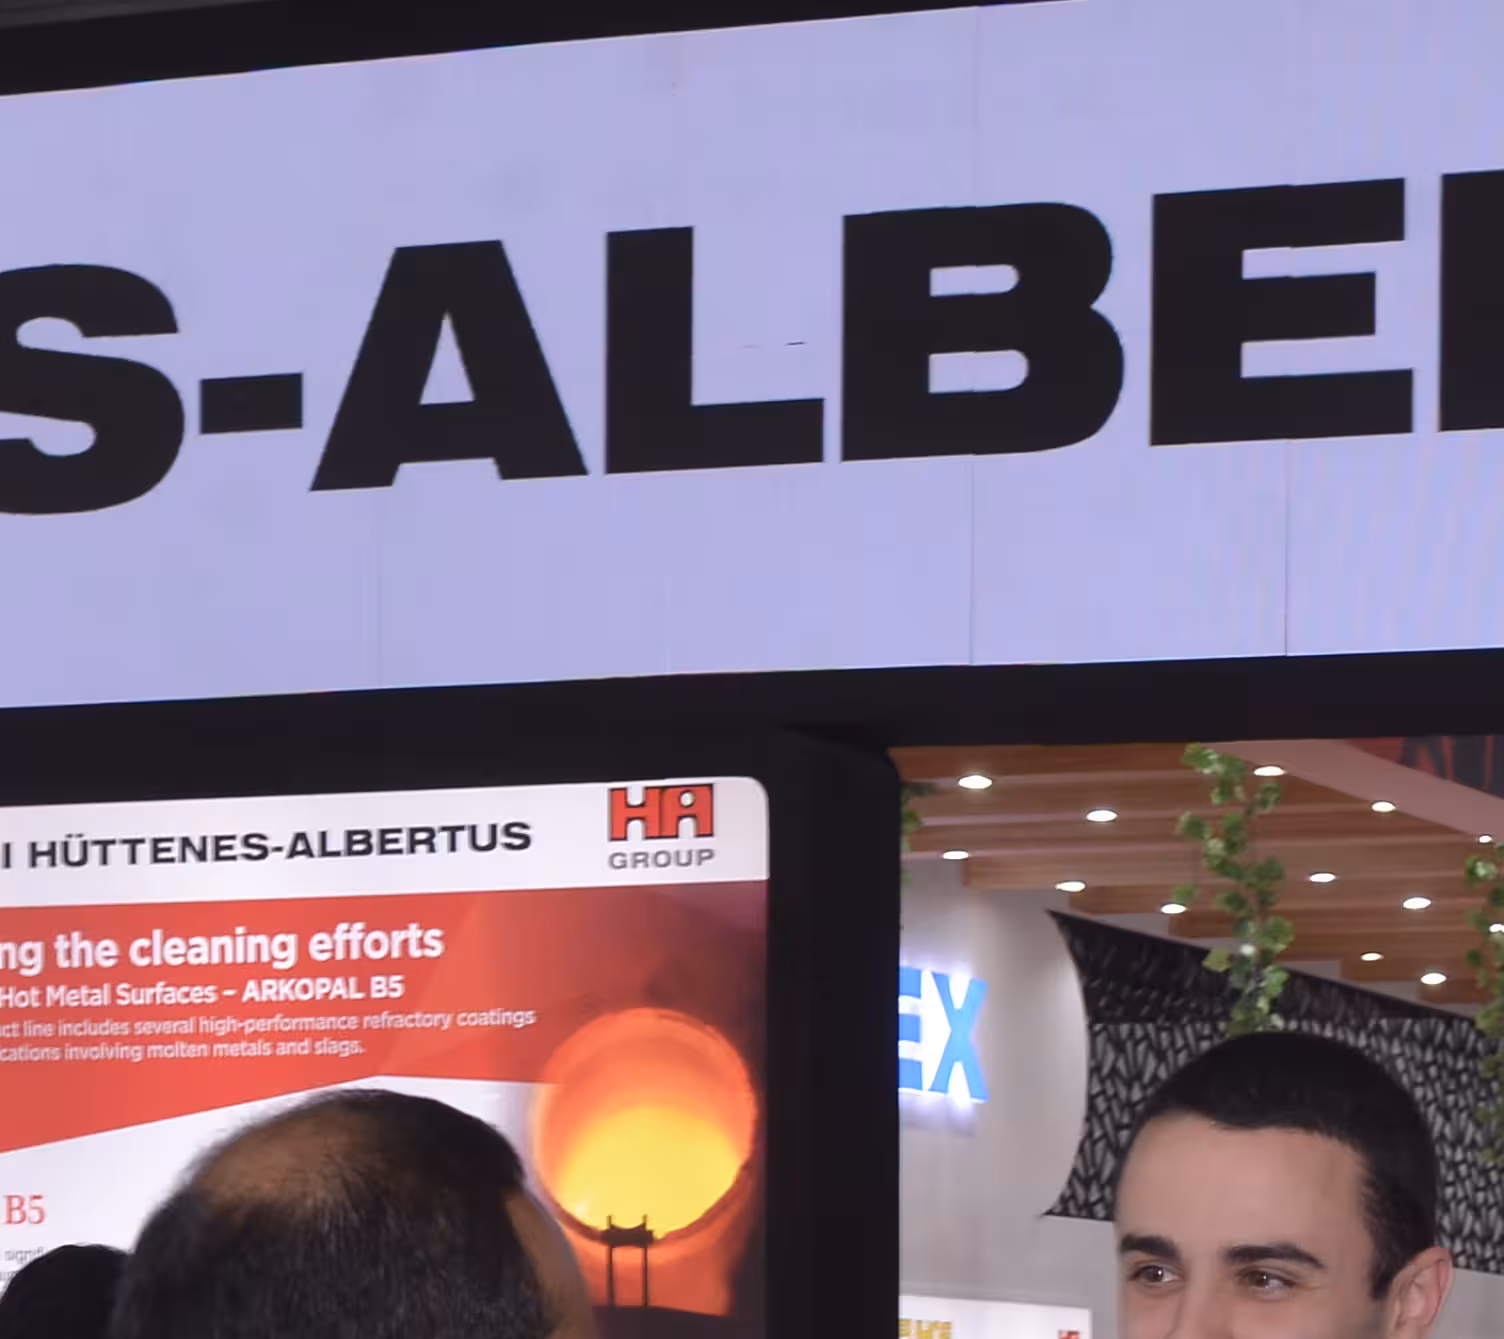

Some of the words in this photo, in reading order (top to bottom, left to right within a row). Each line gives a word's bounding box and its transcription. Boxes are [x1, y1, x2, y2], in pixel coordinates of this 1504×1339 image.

[608, 783, 715, 842] HA
[28, 821, 532, 870] HÜTTENES-ALBERTUS
[608, 847, 715, 870] GROUP
[53, 930, 119, 968] the
[128, 926, 298, 971] cleaning
[308, 921, 445, 962] efforts
[45, 983, 110, 1008] Metal
[115, 981, 219, 1007] Surfaces
[241, 977, 365, 1003] ARKOPAL
[369, 975, 405, 999] B5
[22, 1019, 55, 1037] line
[57, 1018, 129, 1037] includes
[133, 1016, 195, 1035] several
[198, 1013, 359, 1036] high-performance
[362, 1009, 451, 1031] refractory
[456, 1007, 537, 1029] coatings
[64, 1043, 144, 1064] involving
[147, 1041, 209, 1059] molten
[212, 1038, 272, 1058] metals
[275, 1037, 310, 1056] and
[314, 1038, 366, 1058] slags.
[3, 1194, 47, 1226] B5
